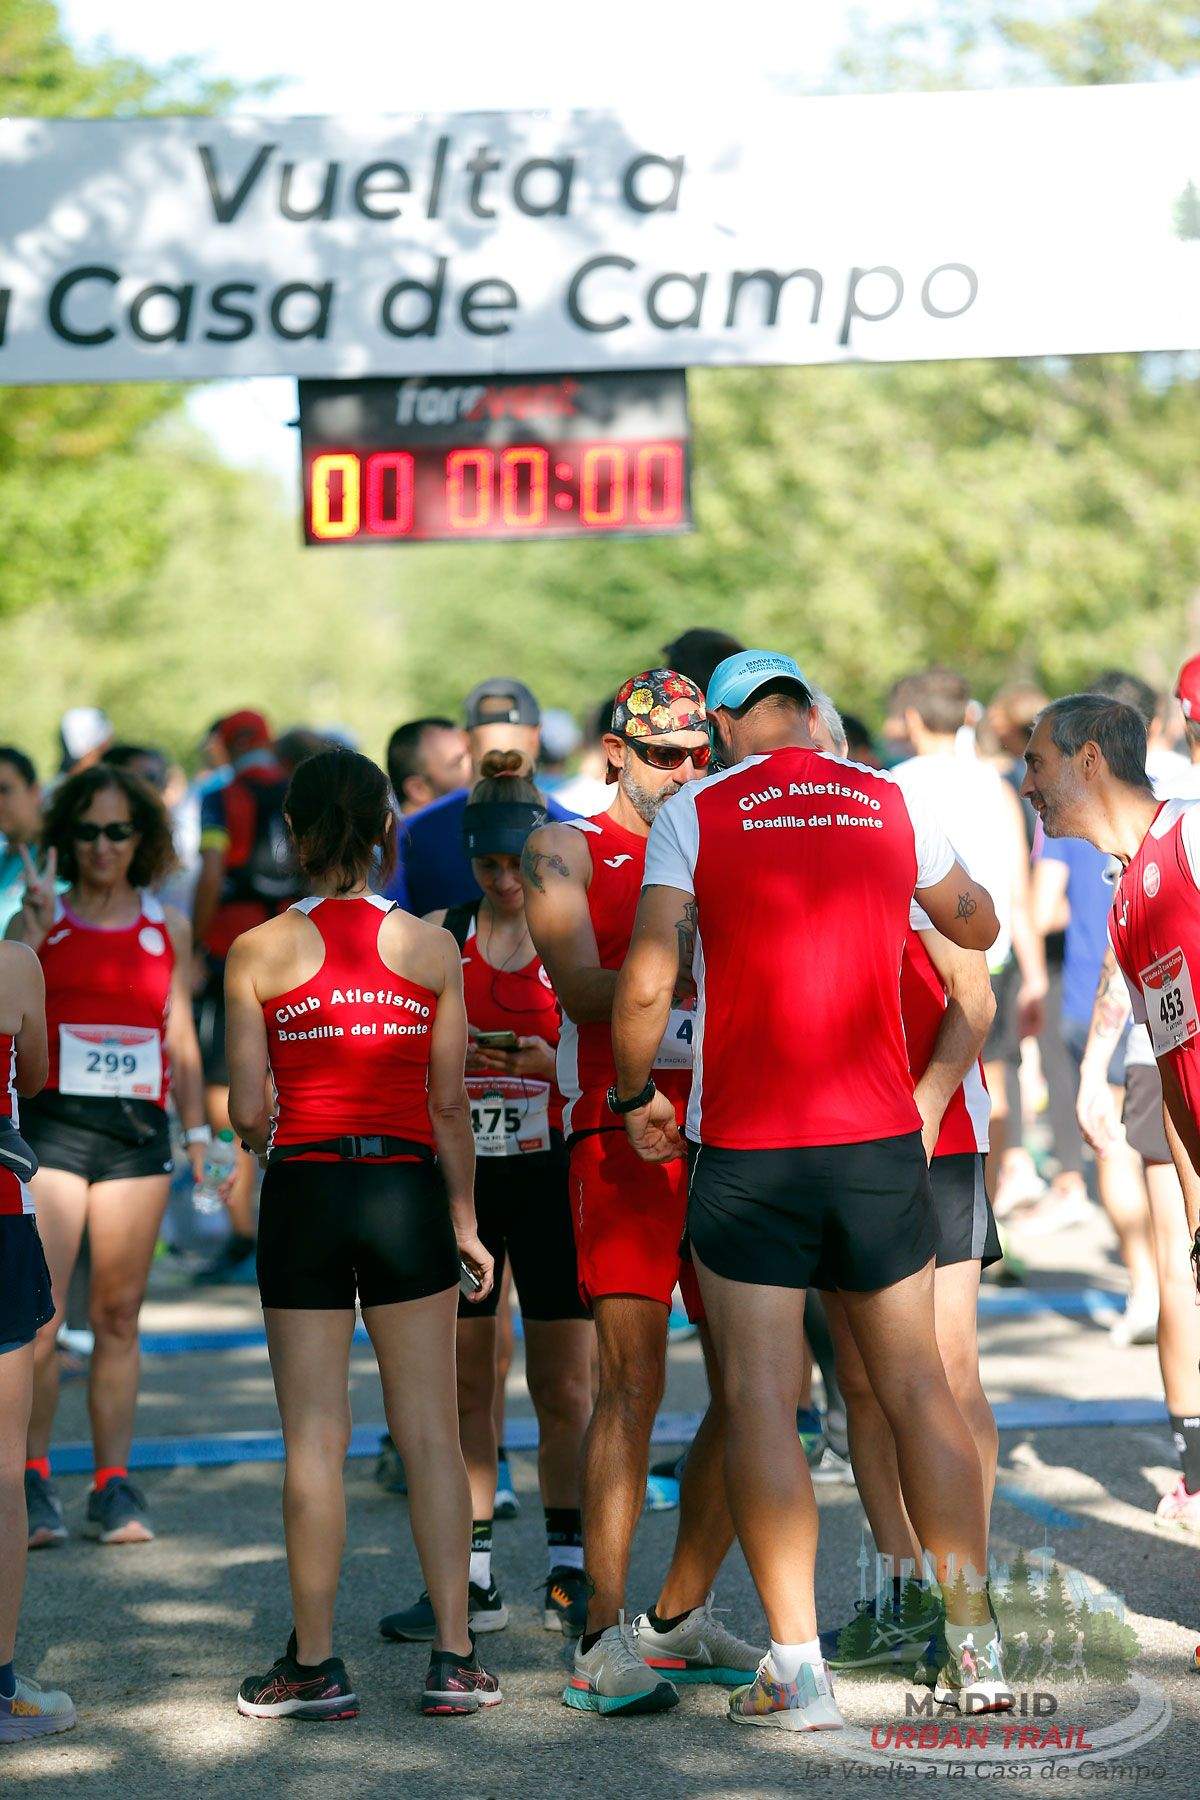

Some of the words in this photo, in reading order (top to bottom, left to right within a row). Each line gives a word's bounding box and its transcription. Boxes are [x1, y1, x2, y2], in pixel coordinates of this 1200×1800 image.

[197, 134, 576, 224] Vuelta
[622, 153, 686, 214] a
[48, 266, 334, 347] Casa
[380, 256, 518, 337] de
[566, 253, 979, 346] Campo
[310, 451, 415, 539] 00
[444, 442, 684, 531] 00:00
[739, 786, 783, 811] Club
[788, 782, 881, 811] Atletismo
[742, 816, 806, 831] Boadilla
[808, 814, 832, 827] del
[836, 814, 883, 829] Monte
[275, 996, 321, 1023] Club
[331, 988, 430, 1018] Atletismo
[1159, 987, 1185, 1024] 453
[278, 1025, 344, 1041] Boadilla
[350, 1023, 377, 1036] del
[383, 1023, 428, 1035] Monte
[86, 1050, 137, 1074] 299
